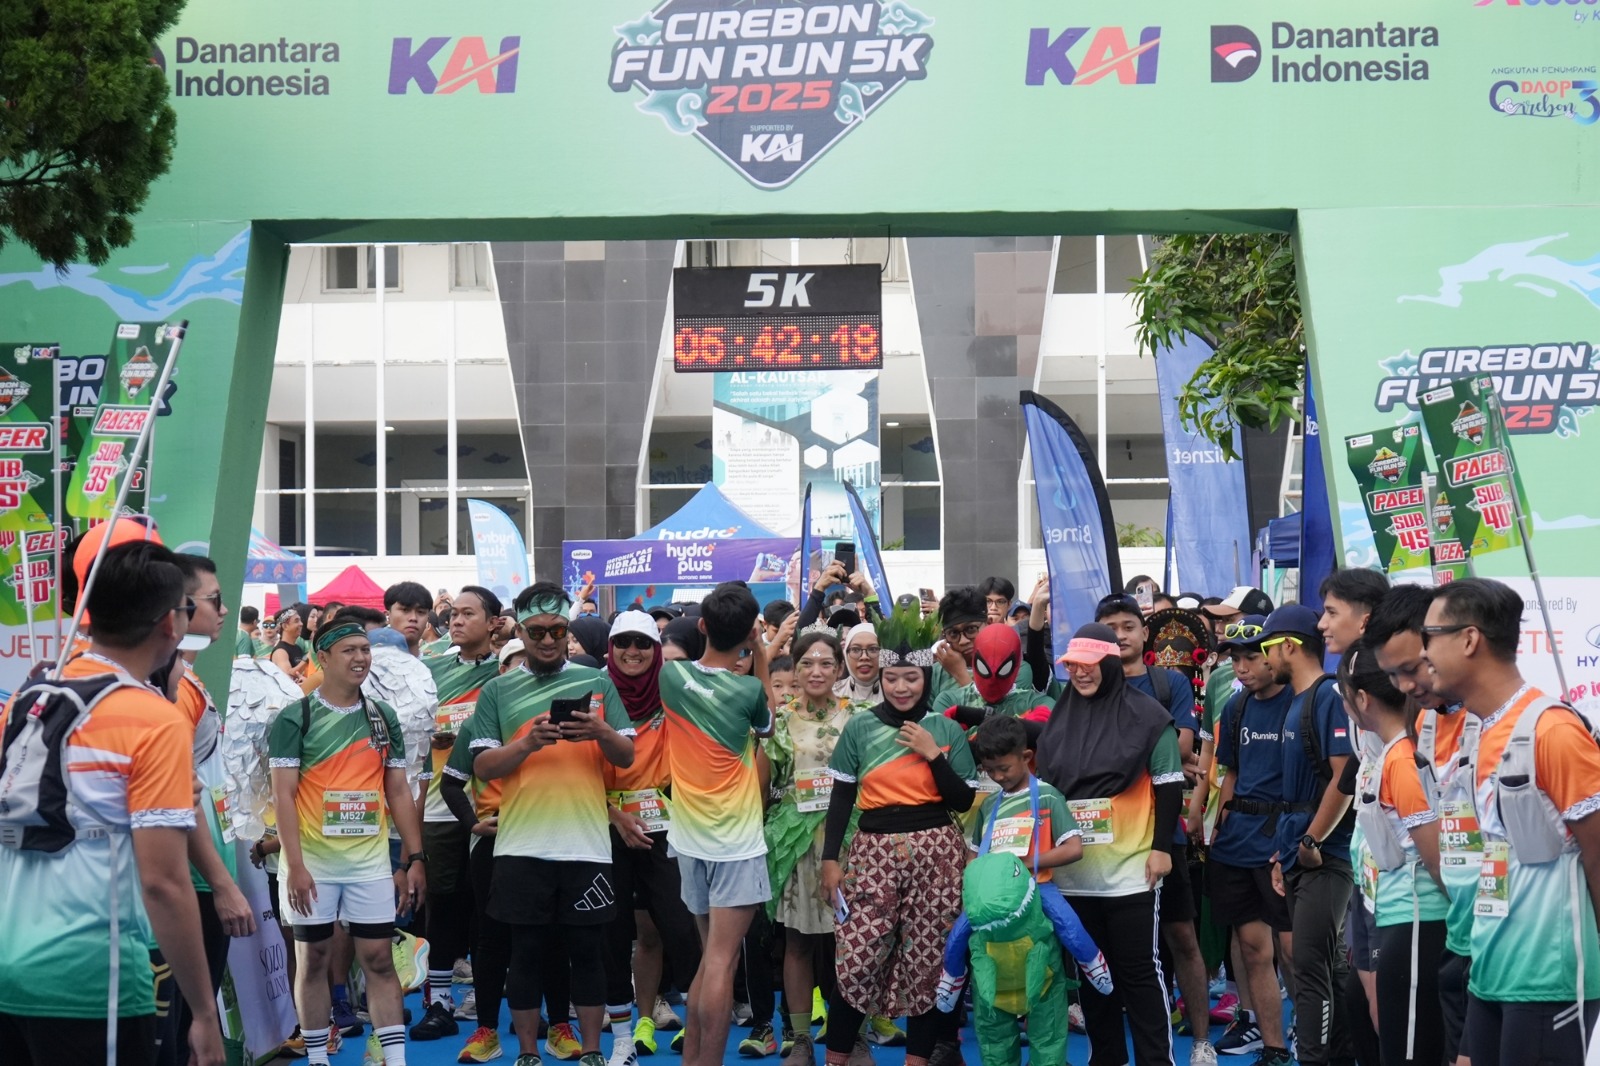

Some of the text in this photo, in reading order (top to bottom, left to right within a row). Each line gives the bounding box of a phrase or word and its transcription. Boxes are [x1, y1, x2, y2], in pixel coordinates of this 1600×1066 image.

[664, 3, 874, 43] CIREBON
[1272, 20, 1439, 50] Danantara
[175, 36, 340, 64] Danantara
[612, 37, 927, 84] FUN RUN 5K
[1025, 26, 1162, 86] KAI
[387, 36, 521, 95] KAI
[1272, 53, 1430, 84] Indonesia
[1491, 66, 1597, 75] ANGKUTAN PENUMPANG
[175, 69, 330, 97] Indonesia
[706, 80, 833, 114] 2025
[1489, 80, 1576, 118] Cirebon
[1521, 80, 1600, 126] DAOP 3
[750, 124, 794, 132] SUPPORTED BY
[740, 133, 804, 162] KAI
[743, 272, 816, 308] 5K
[1419, 344, 1587, 374] CIREBON
[1490, 373, 1565, 402] UN
[96, 410, 149, 430] PACER
[1501, 404, 1554, 430] 25
[0, 427, 47, 447] CER
[95, 442, 124, 461] SUB
[0, 481, 27, 508] 5'
[1475, 483, 1504, 505] SUB
[1393, 512, 1424, 531] SUB
[26, 531, 67, 552] CER
[636, 547, 653, 557] PAS
[666, 542, 715, 561] hydro
[604, 565, 652, 578] MAKSIMAL
[605, 554, 653, 571] HIDRASI
[678, 559, 713, 575] plus
[1525, 597, 1577, 613] onsred By
[1516, 630, 1563, 654] TE
[1252, 731, 1279, 741] Running
[814, 786, 833, 796] F48
[340, 802, 367, 811] RIFKA
[640, 800, 659, 809] EMA
[640, 808, 661, 819] F330
[340, 811, 366, 820] M527
[1077, 820, 1094, 829] 223
[260, 943, 284, 977] SOZO
